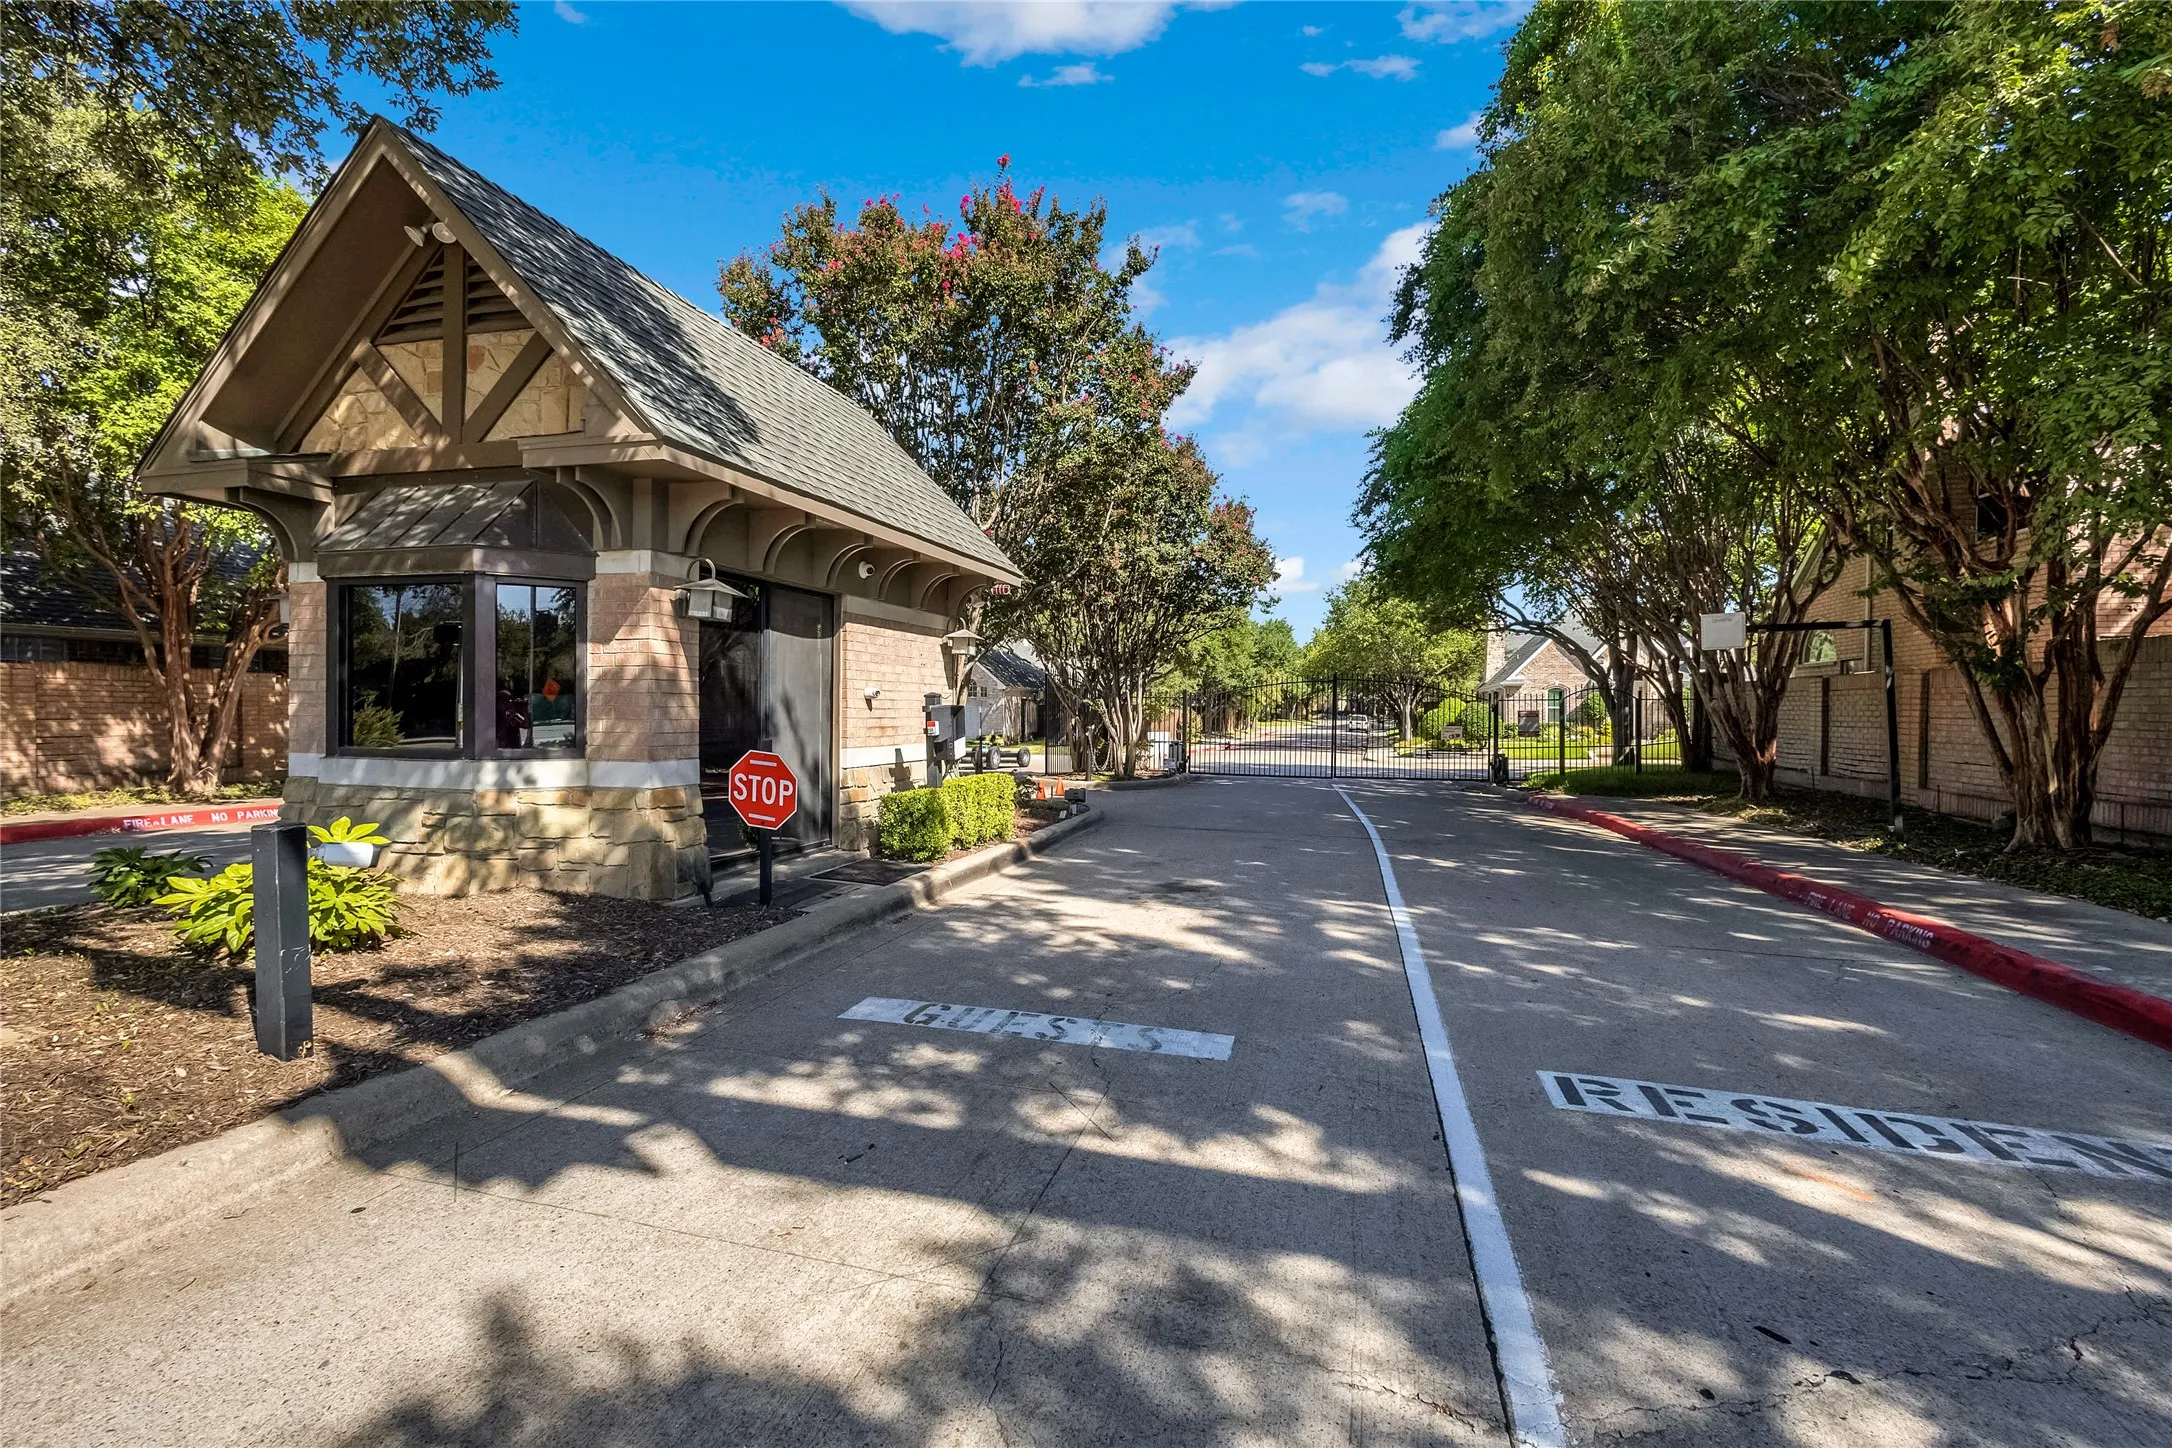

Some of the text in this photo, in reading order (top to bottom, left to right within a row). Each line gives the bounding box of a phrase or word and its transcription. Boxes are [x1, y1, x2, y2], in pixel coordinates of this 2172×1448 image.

[733, 773, 794, 807] STOP
[123, 809, 279, 829] FIRE LANE NO PARKIN
[1828, 899, 1856, 920] LANE
[1862, 911, 1881, 929] NO
[1884, 918, 1935, 949] PARKING
[1552, 1075, 2172, 1180] RESIDEN
